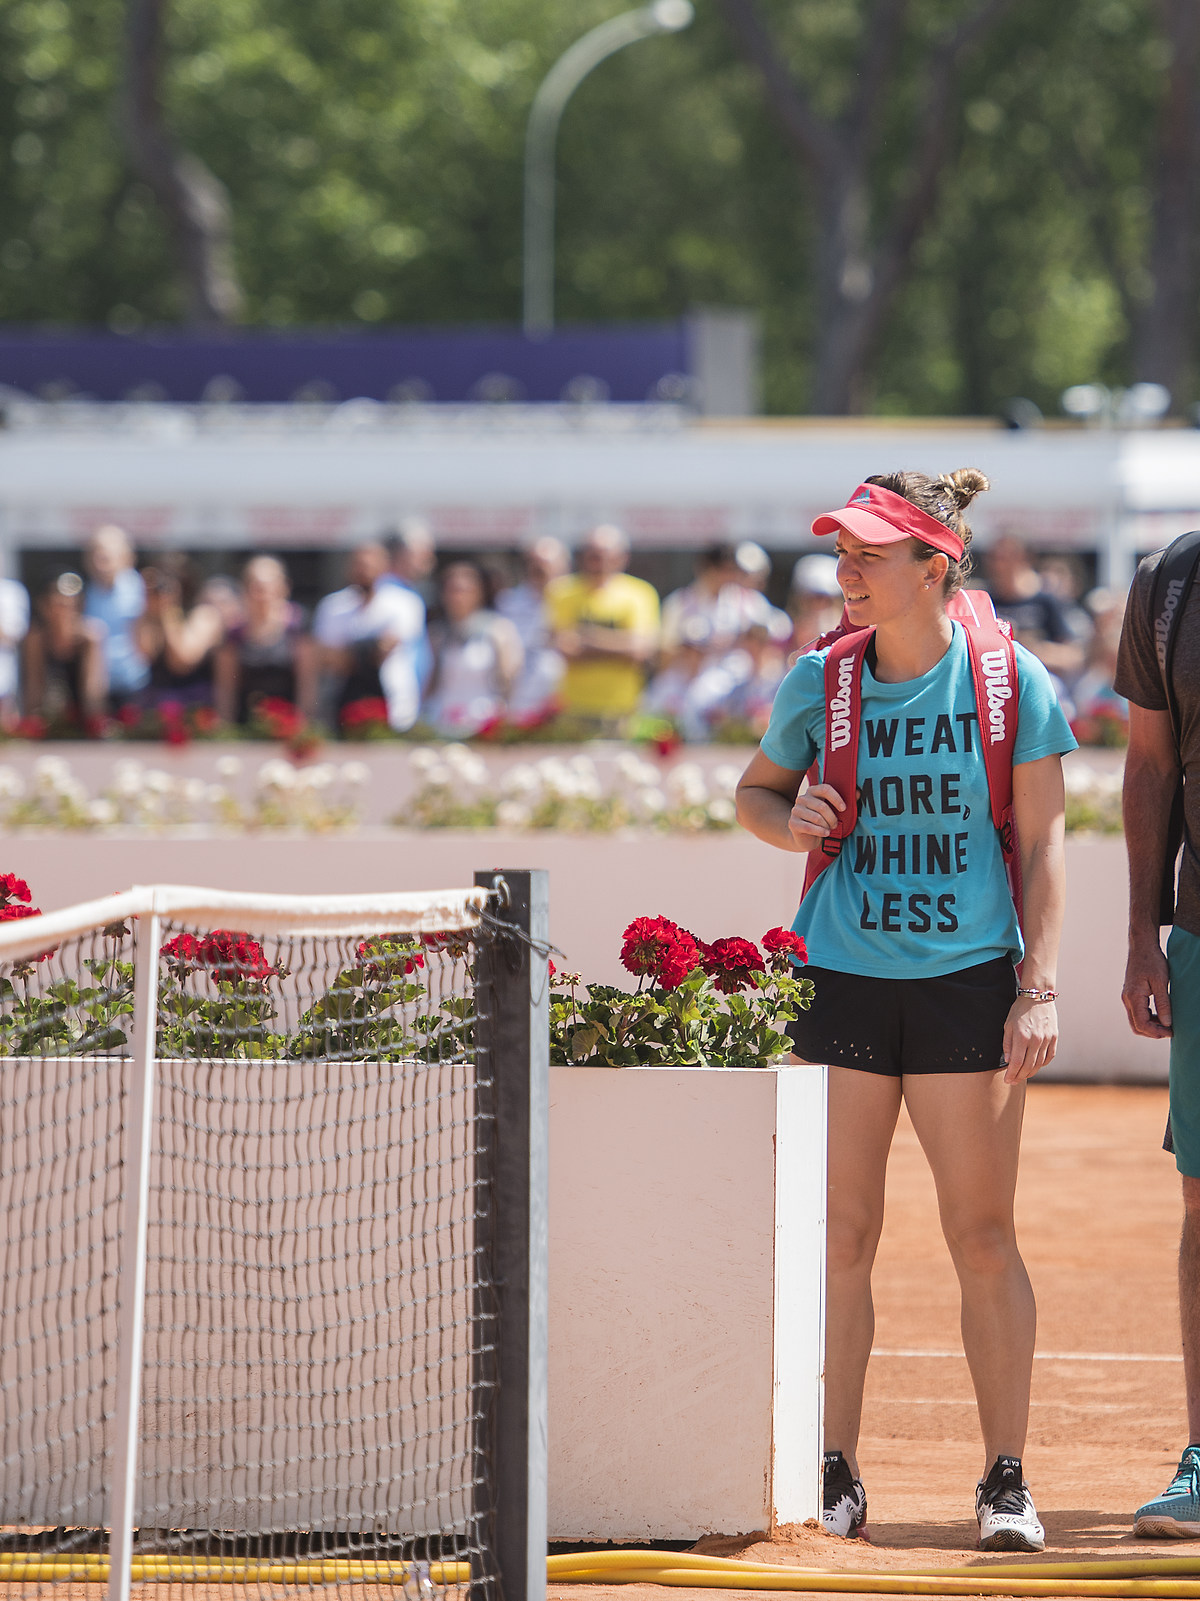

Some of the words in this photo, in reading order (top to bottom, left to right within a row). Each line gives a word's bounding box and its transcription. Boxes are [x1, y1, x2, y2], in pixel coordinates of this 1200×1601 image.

[831, 653, 855, 751] Wilson
[980, 648, 1012, 746] Wilson
[865, 712, 977, 758] WEAT
[857, 774, 971, 821] MORE,
[854, 832, 969, 875] WHINE
[860, 891, 959, 933] LESS
